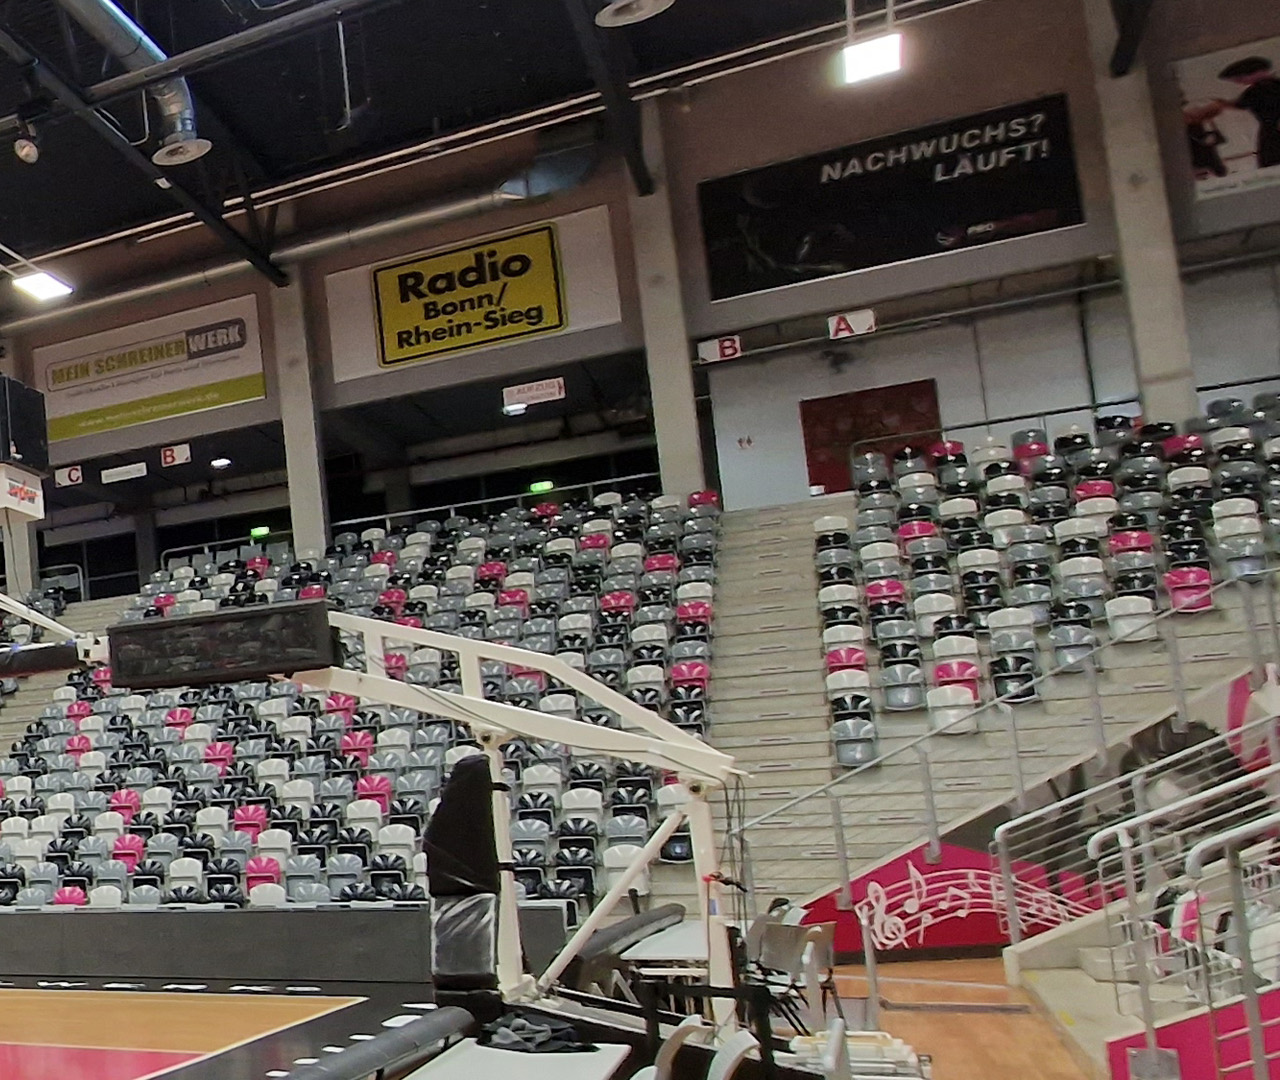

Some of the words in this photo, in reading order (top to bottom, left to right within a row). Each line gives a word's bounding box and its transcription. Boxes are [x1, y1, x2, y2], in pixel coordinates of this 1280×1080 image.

[820, 113, 1045, 184] NACHWUCHS?
[397, 250, 532, 303] Radio
[423, 283, 508, 321] Bonn/
[396, 304, 544, 350] Rhein-Sieg
[832, 315, 856, 337] A
[51, 364, 90, 385] MEIN
[95, 339, 186, 375] SCHREINER
[189, 325, 241, 351] WERK
[718, 337, 740, 359] B
[68, 467, 80, 483] C
[163, 449, 175, 464] B
